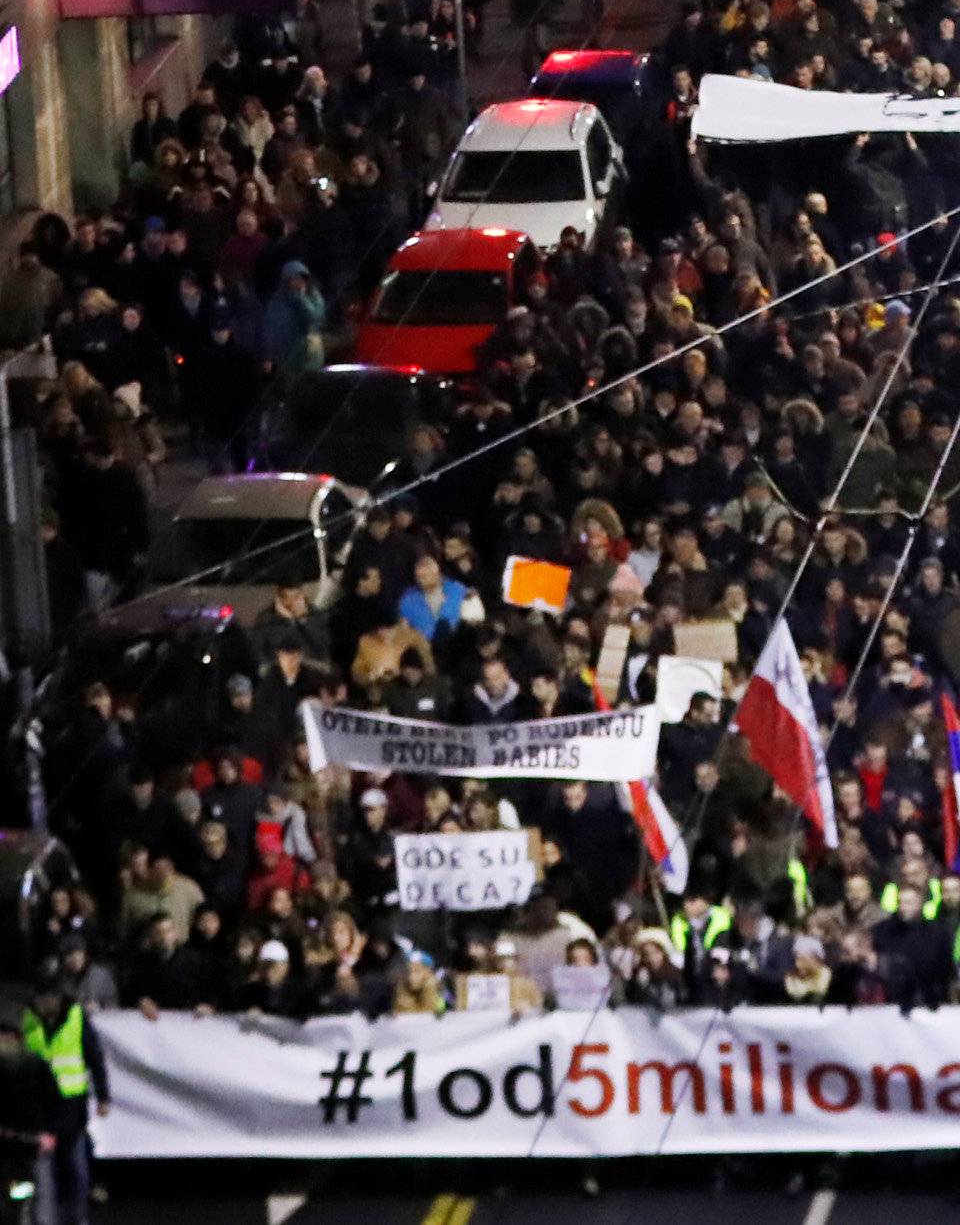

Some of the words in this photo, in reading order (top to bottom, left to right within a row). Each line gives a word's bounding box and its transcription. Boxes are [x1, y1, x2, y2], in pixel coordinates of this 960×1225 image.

[381, 740, 477, 767] STOLEN
[492, 744, 581, 769] BABIES
[402, 845, 464, 869] GDE
[478, 846, 519, 868] SU
